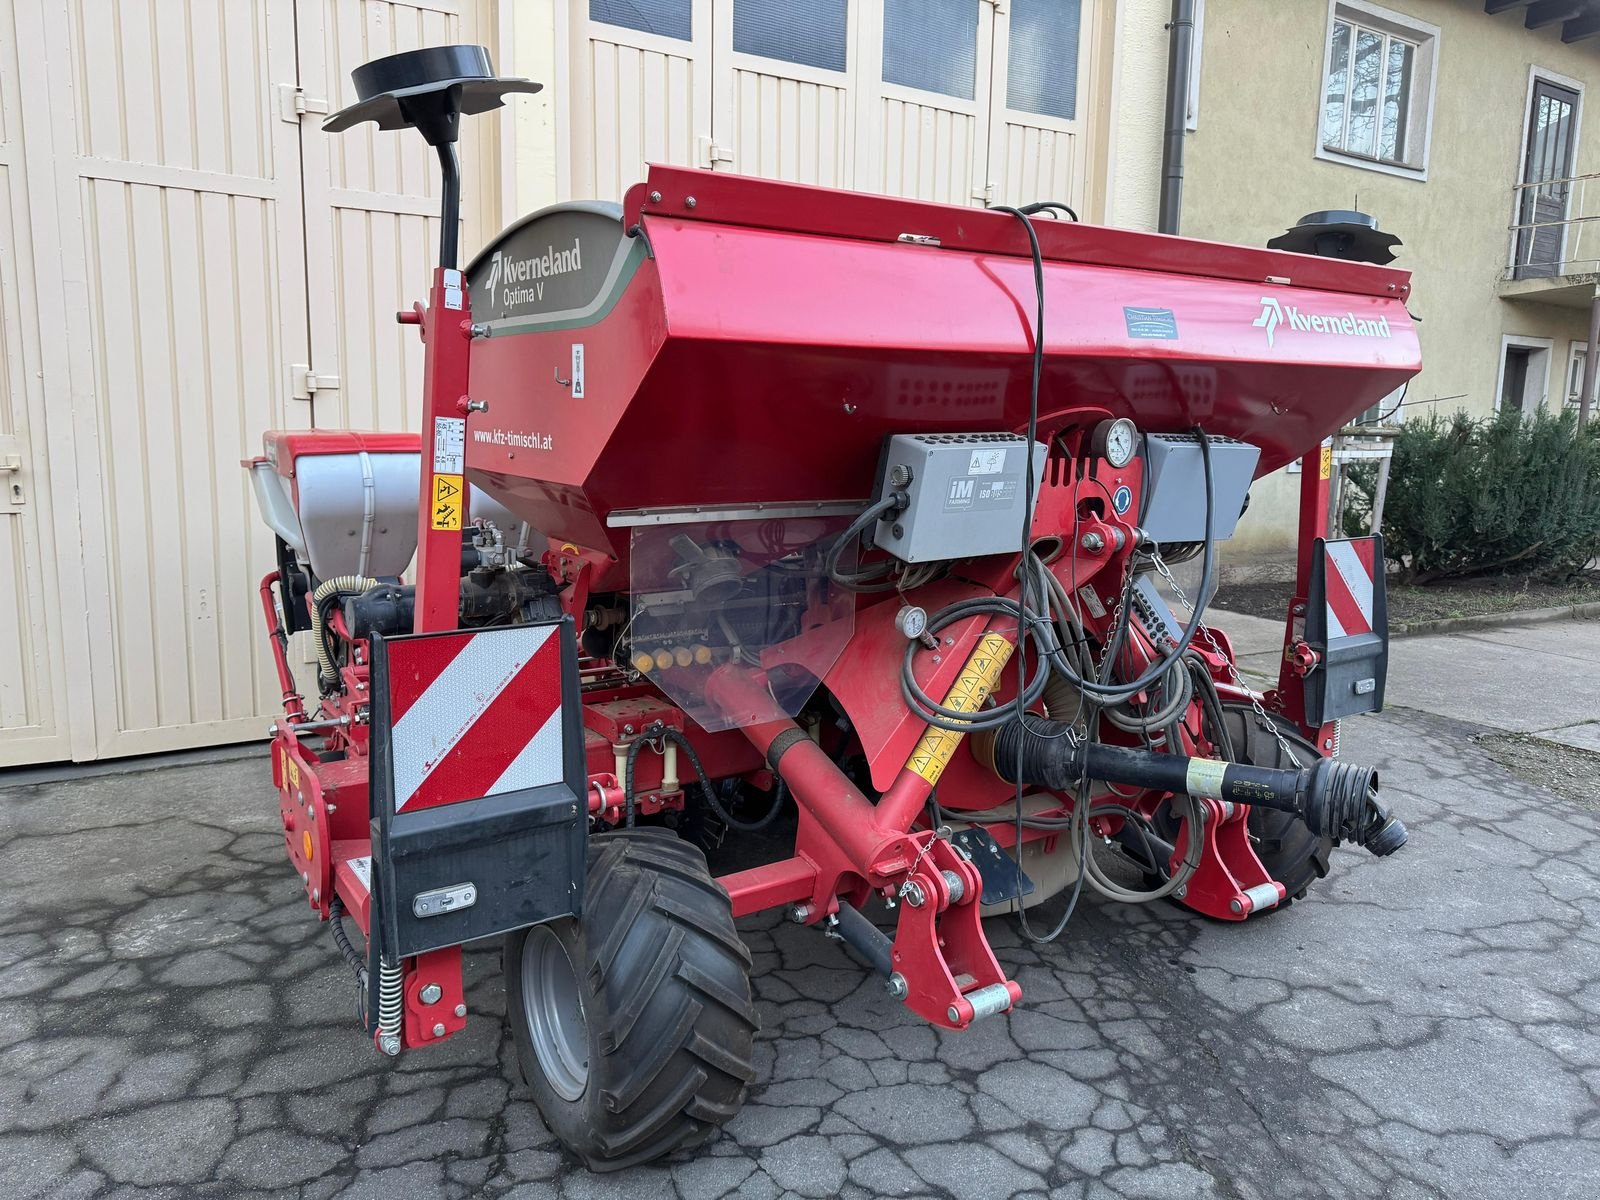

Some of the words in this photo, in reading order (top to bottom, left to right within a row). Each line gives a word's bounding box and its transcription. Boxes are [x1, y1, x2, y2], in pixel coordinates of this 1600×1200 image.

[503, 238, 581, 285] Kverneland
[503, 286, 534, 309] Optima
[536, 281, 544, 301] V
[1284, 305, 1392, 338] Kverneland
[473, 429, 553, 450] www.kfz-timischl.at
[950, 480, 974, 498] iM
